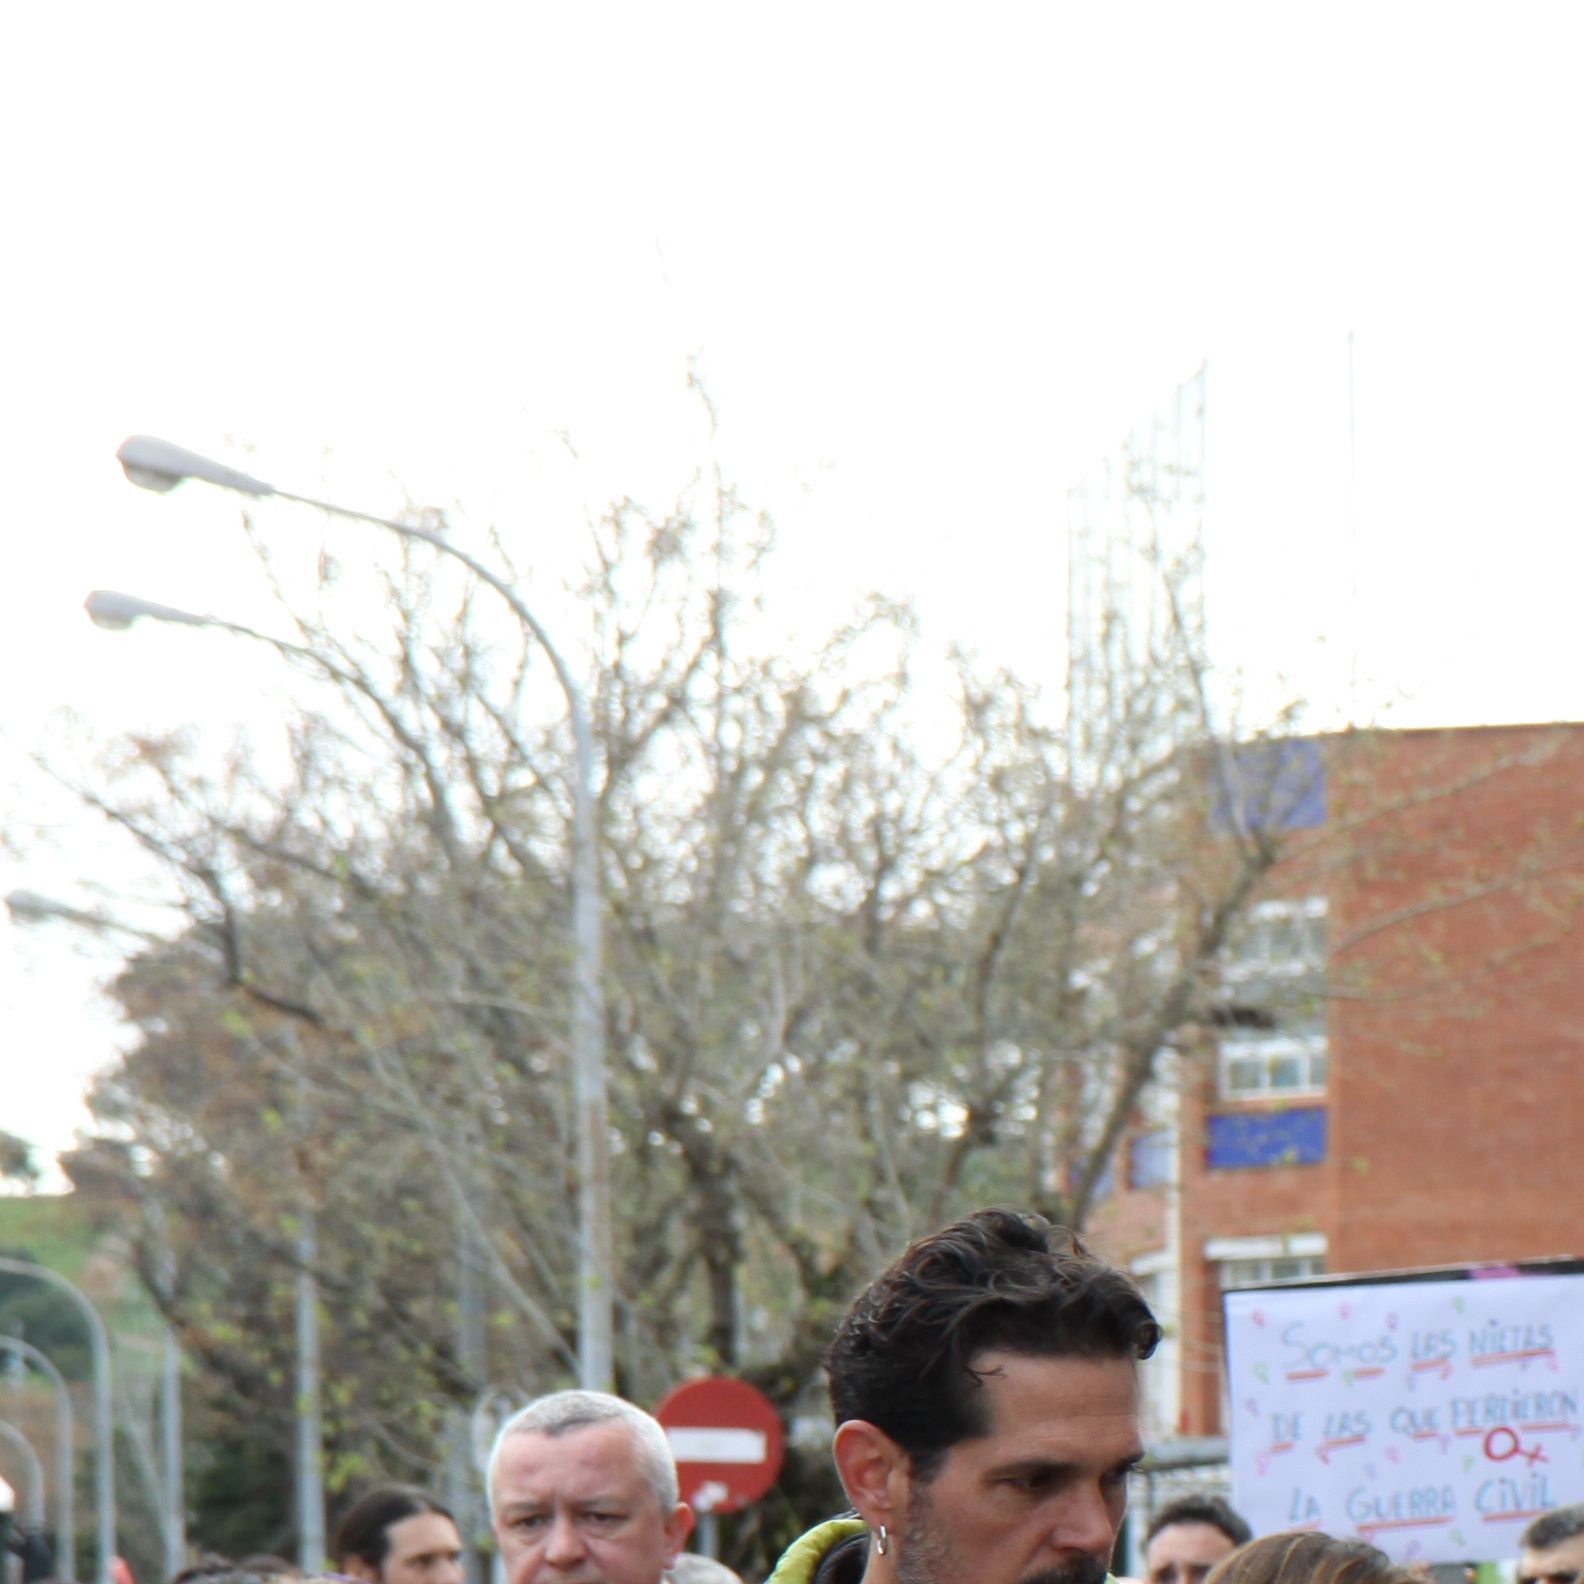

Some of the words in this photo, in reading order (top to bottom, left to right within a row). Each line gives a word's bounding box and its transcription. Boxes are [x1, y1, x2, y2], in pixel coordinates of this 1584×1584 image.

[1322, 1409, 1372, 1439] LAS
[1390, 1406, 1441, 1437] QUE
[1288, 1485, 1320, 1522] LA
[1346, 1484, 1457, 1522] GUERRA
